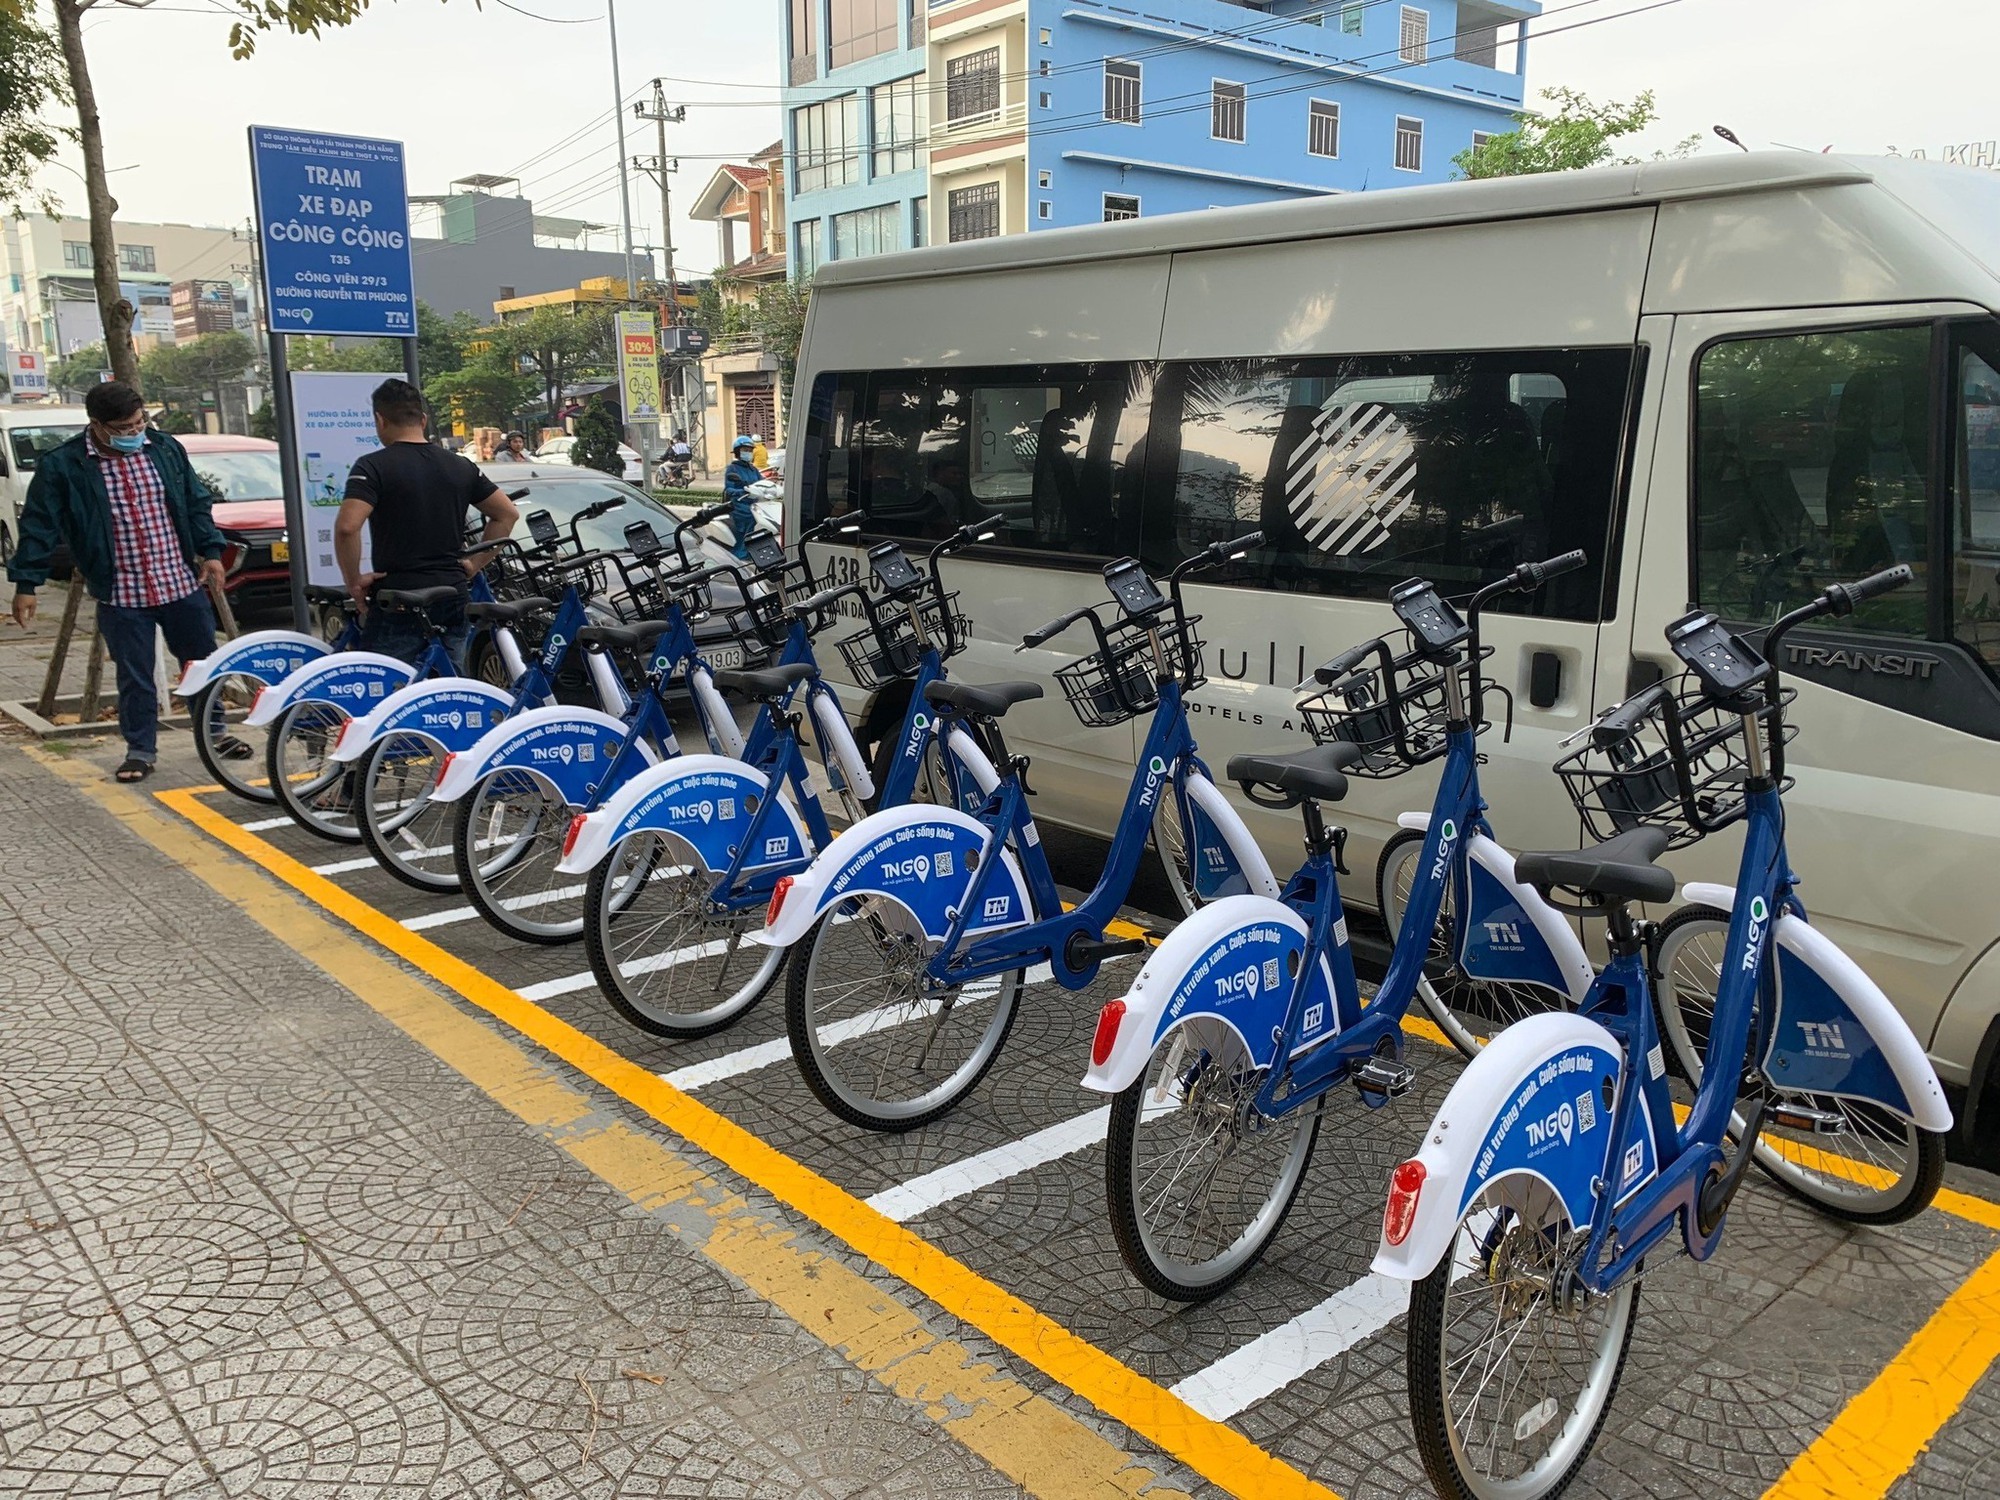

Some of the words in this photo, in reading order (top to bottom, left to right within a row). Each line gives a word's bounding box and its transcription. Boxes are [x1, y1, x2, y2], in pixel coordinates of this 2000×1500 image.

[260, 141, 283, 150] TRUNG
[304, 165, 362, 192] TRẠM
[298, 194, 325, 215] XE
[330, 197, 373, 223] ĐẠP
[269, 218, 335, 245] CÔNG
[341, 223, 404, 252] CỘNG
[330, 254, 351, 265] T35
[295, 270, 331, 284] CÔNG
[333, 273, 359, 285] VIÊN
[361, 276, 387, 287] 29/3
[275, 286, 312, 298] ĐƯỜNG
[314, 286, 351, 300] NGUYỄN
[353, 291, 367, 301] TRI
[368, 293, 408, 303] PHƯƠNG
[384, 311, 409, 325] TN
[627, 341, 652, 353] 30%
[305, 421, 316, 429] XE
[337, 420, 363, 429] CÔNG
[1785, 644, 1940, 679] TRANSIT
[624, 813, 641, 830] Môi
[638, 793, 664, 817] trường
[662, 785, 683, 800] xanh.
[682, 776, 701, 792] Cuộc
[701, 774, 719, 787] sống
[832, 872, 851, 894] Môi
[847, 848, 876, 878] trường
[873, 836, 896, 856] xanh.
[895, 827, 916, 843] Cuộc
[915, 824, 935, 838] sống
[1482, 922, 1521, 944] TN
[1169, 992, 1186, 1019] Môi
[1183, 964, 1210, 997] trường
[1207, 944, 1229, 968] xanh.
[1228, 931, 1246, 949] Cuộc
[1247, 925, 1264, 943] sống
[1796, 1021, 1846, 1049] TN
[1475, 1145, 1496, 1181] Môi
[1491, 1105, 1520, 1151] trường
[1516, 1079, 1540, 1111] xanh.
[1538, 1063, 1558, 1087] Cuộc
[1558, 1053, 1576, 1075] sống
